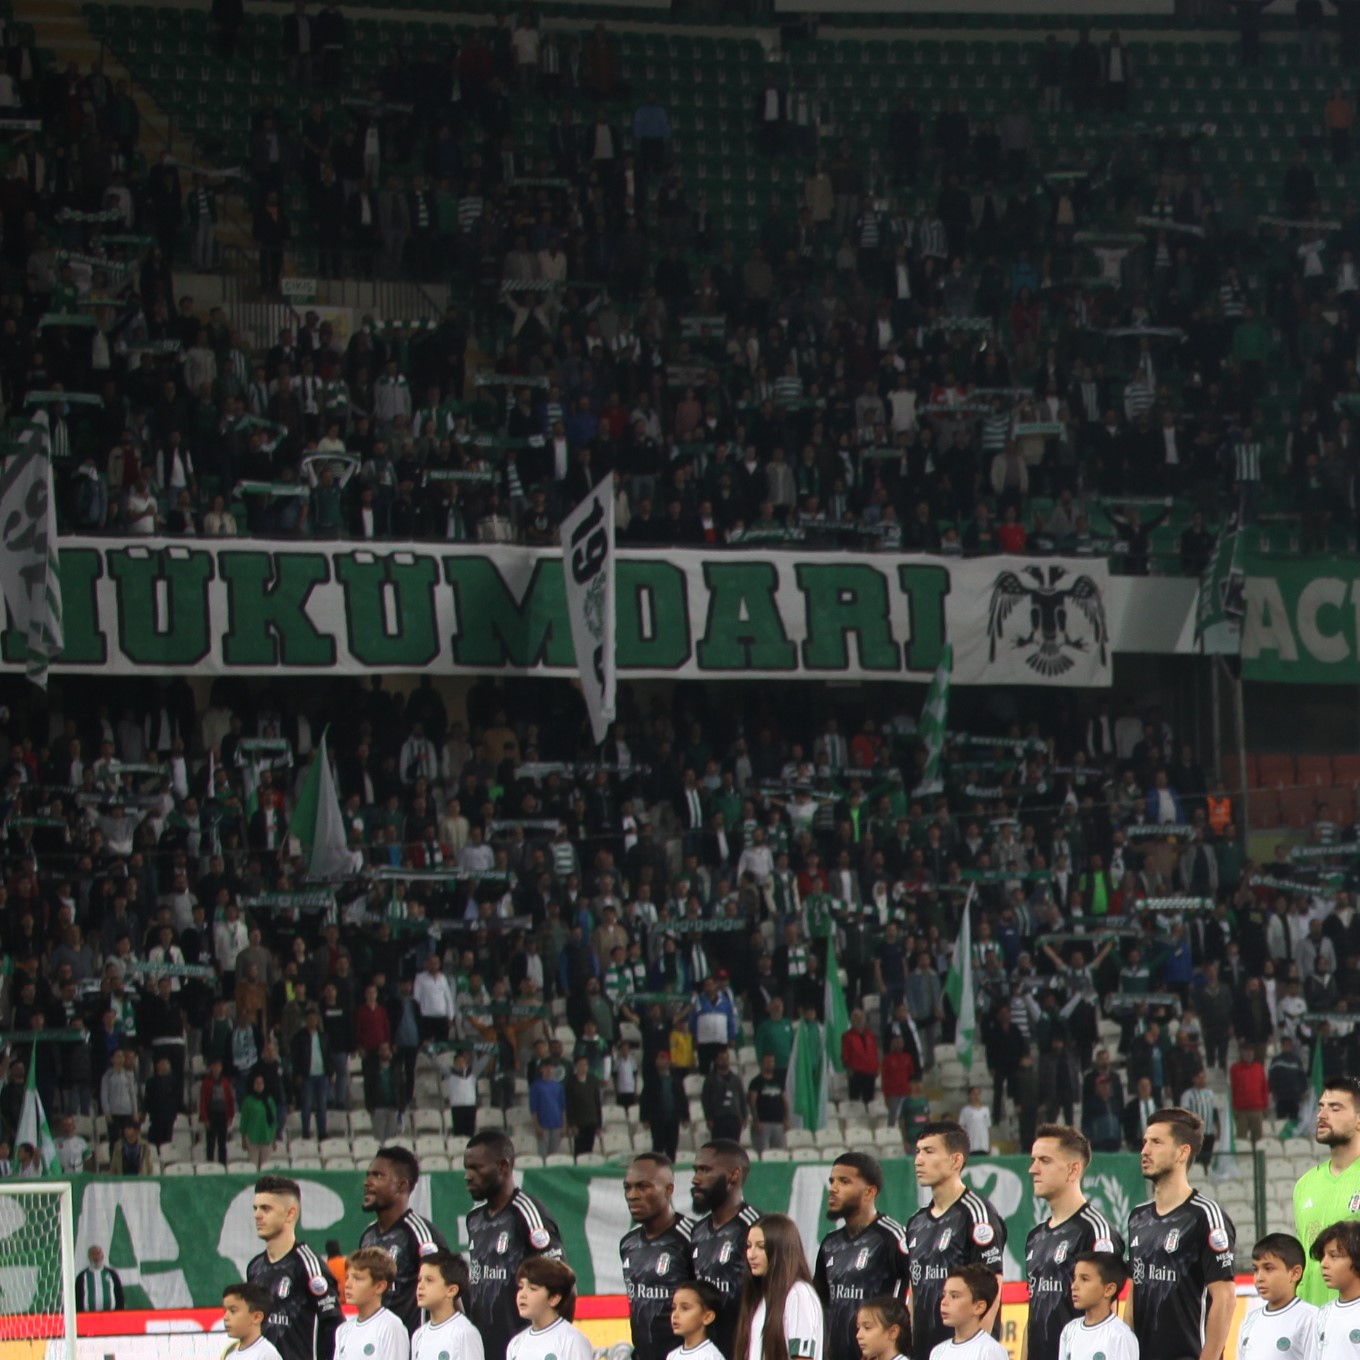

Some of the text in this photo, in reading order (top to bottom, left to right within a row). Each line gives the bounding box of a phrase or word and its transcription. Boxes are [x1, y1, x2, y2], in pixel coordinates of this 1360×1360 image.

[483, 1265, 507, 1280] Rain
[925, 1265, 948, 1281] Rain
[1149, 1264, 1176, 1282] Rain
[836, 1284, 864, 1300] Rain
